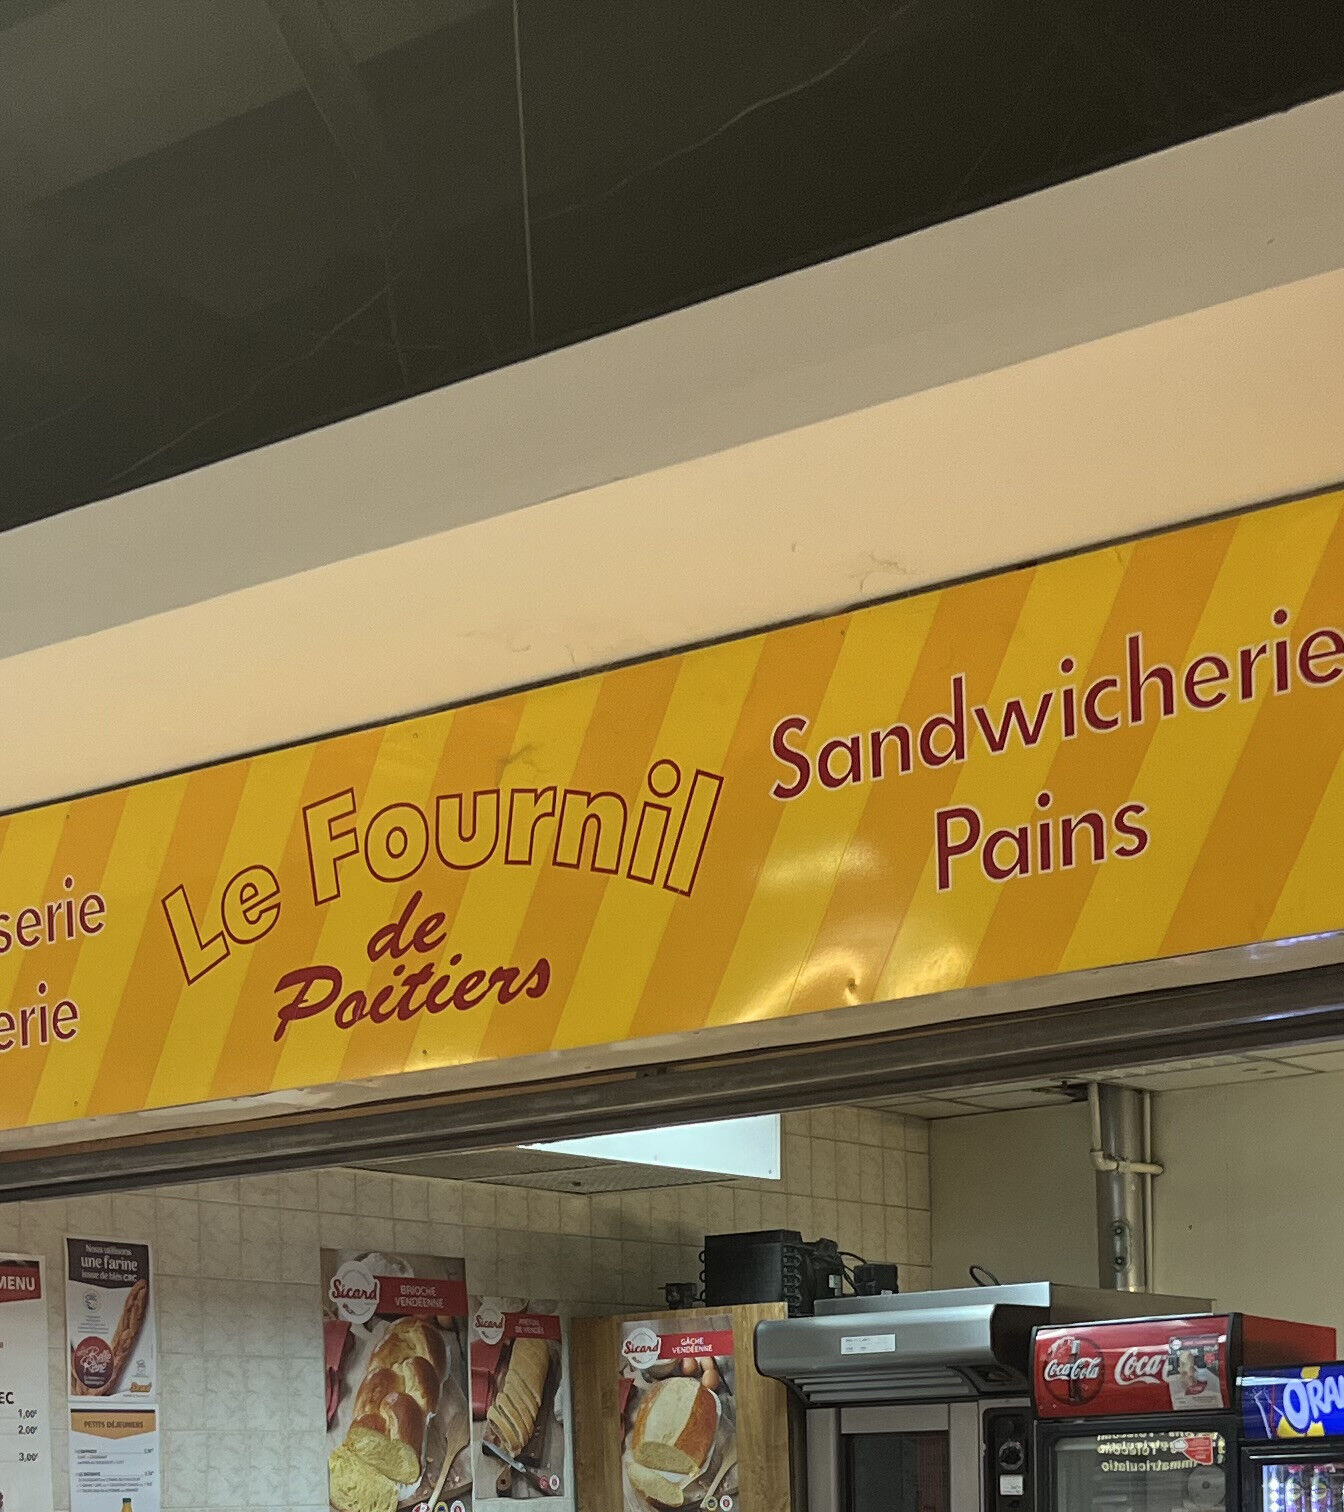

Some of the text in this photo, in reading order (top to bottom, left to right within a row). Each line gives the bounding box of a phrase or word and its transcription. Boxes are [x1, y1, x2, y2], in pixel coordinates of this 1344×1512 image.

[934, 791, 1150, 893] Pains
[161, 757, 725, 986] Le Fournil
[366, 889, 448, 967] de
[272, 951, 553, 1043] Poitiers
[80, 1254, 138, 1272] une farine
[330, 1279, 378, 1301] Sicard
[400, 1284, 437, 1296] BRIOCHE
[474, 1314, 504, 1329] Sicard
[623, 1341, 660, 1354] Sicard
[1043, 1357, 1103, 1381] Coca-Cola
